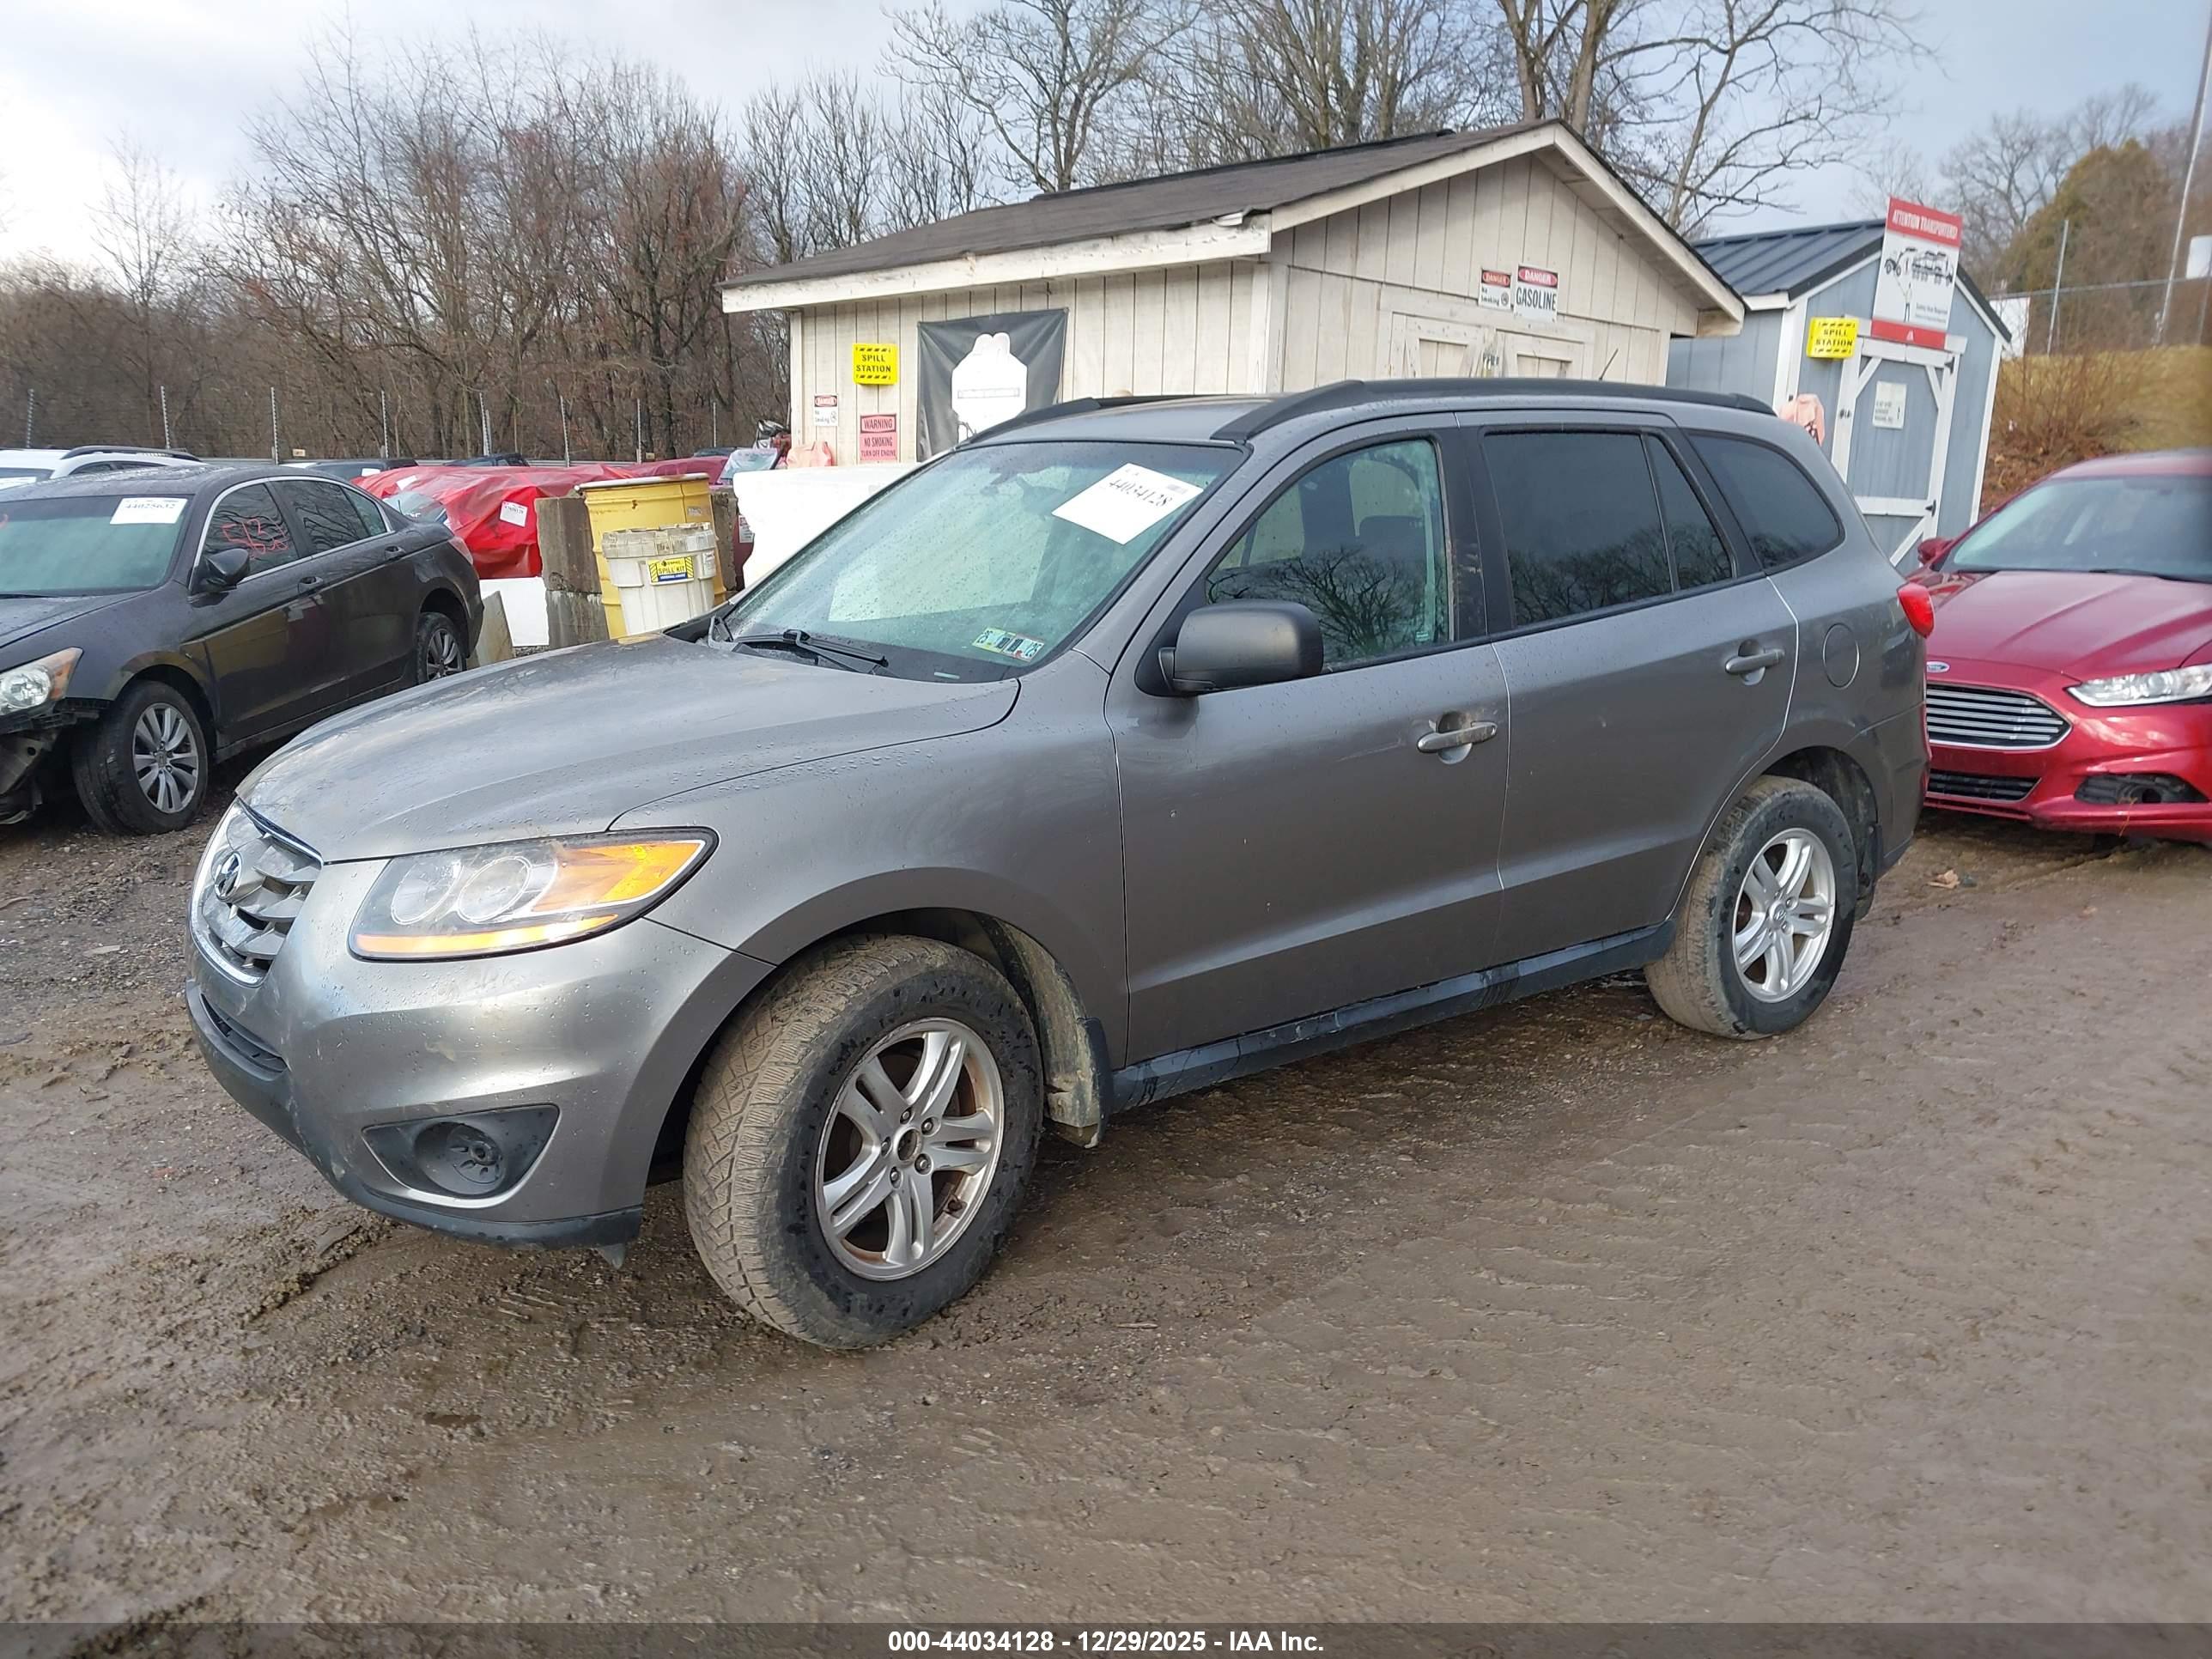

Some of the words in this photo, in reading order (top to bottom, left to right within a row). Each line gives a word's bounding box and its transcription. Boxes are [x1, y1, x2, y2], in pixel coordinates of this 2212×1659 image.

[1525, 270, 1552, 285] DANGER
[1516, 287, 1556, 311] GASOLINE
[1816, 338, 1853, 347] STATION
[861, 354, 885, 362] SPILL
[856, 364, 891, 374] STATION
[864, 419, 893, 429] WARNING
[864, 437, 871, 447] NO
[872, 436, 893, 448] SMOKING
